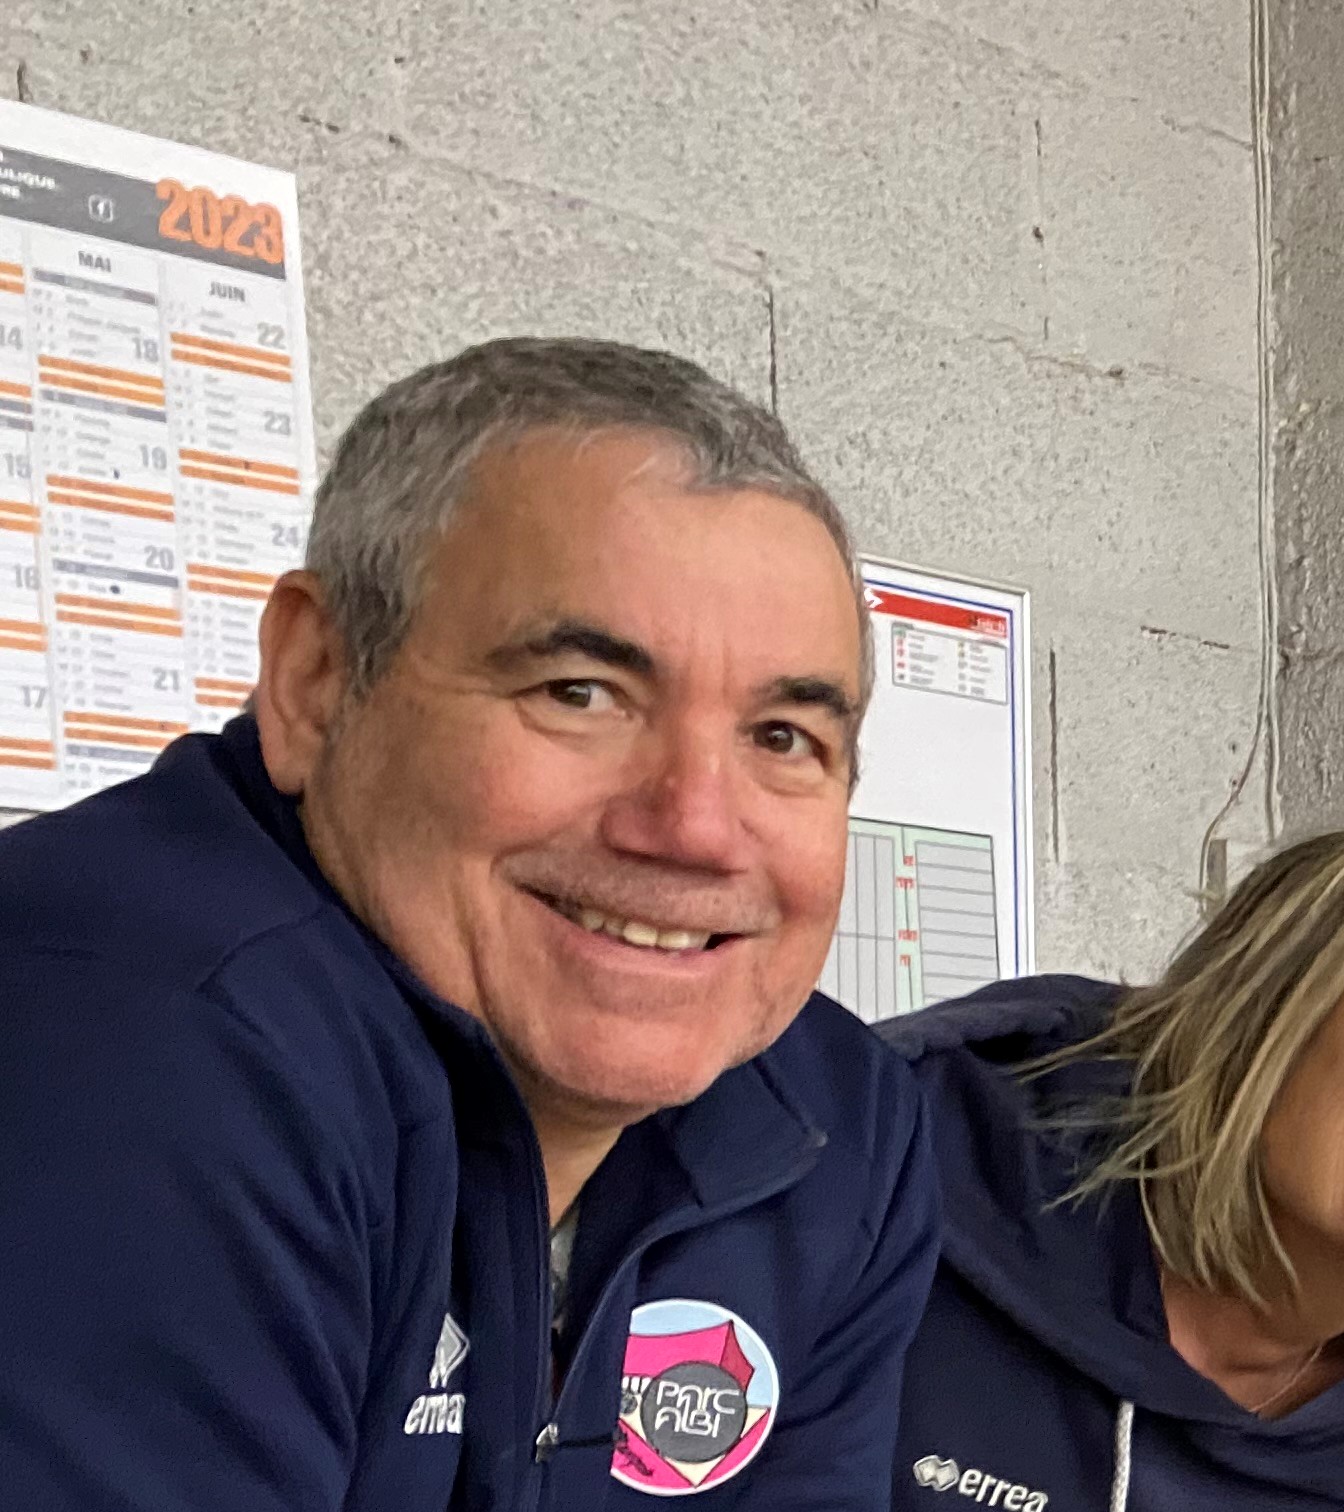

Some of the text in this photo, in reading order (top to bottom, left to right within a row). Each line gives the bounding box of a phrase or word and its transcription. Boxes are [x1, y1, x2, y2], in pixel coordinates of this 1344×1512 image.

[156, 177, 284, 263] 2023
[78, 250, 112, 273] MAI
[209, 280, 246, 302] JUIN
[257, 321, 286, 349] 22
[144, 545, 175, 571] 20
[153, 667, 180, 692] 21
[20, 685, 47, 709] 17
